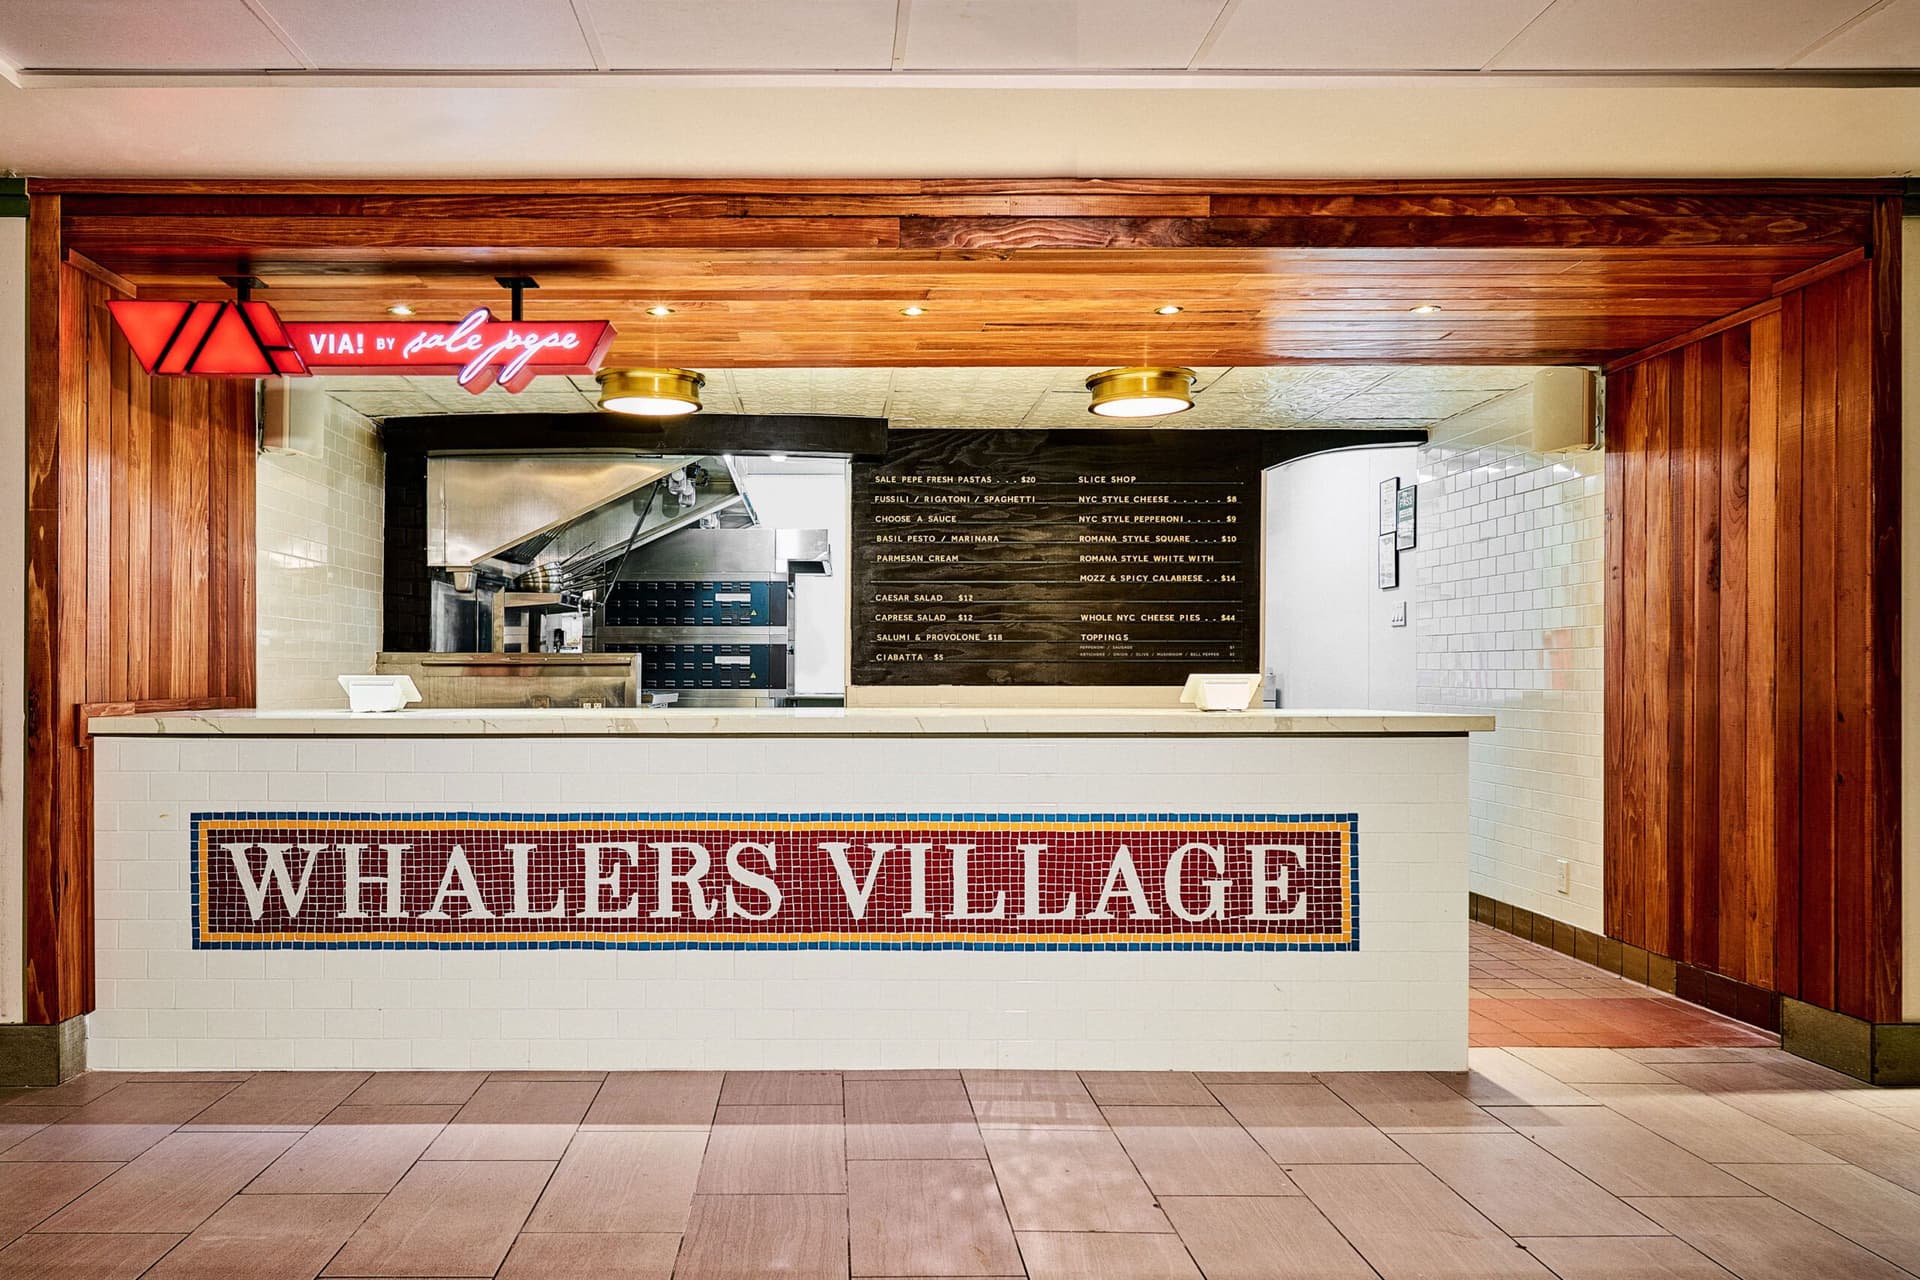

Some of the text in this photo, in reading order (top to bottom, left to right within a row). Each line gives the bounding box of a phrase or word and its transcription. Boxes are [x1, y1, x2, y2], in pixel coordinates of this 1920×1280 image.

[309, 333, 364, 354] VIA!
[376, 337, 395, 350] BY
[874, 495, 909, 503] FUSSILI
[924, 495, 970, 503] RIGATONI
[983, 495, 1035, 503] SPAGHETTI
[1078, 495, 1237, 503] NYC STYLE CHEESE $8
[875, 515, 957, 523] CHOOSE A SAUCE
[1078, 515, 1237, 523] NYC STYLE PEPPERONI $9
[876, 535, 903, 543] BASIL
[907, 535, 936, 543] PESTO
[951, 535, 1000, 543] MARINARA
[1079, 535, 1237, 543] ROMANA STYLE SQUARE $10
[875, 614, 973, 622] CAPRESE SALAD $12
[1080, 614, 1235, 622] WHOLE NYC CHEESE PIES $44
[221, 842, 1308, 922] WHALERS VILLAGE
